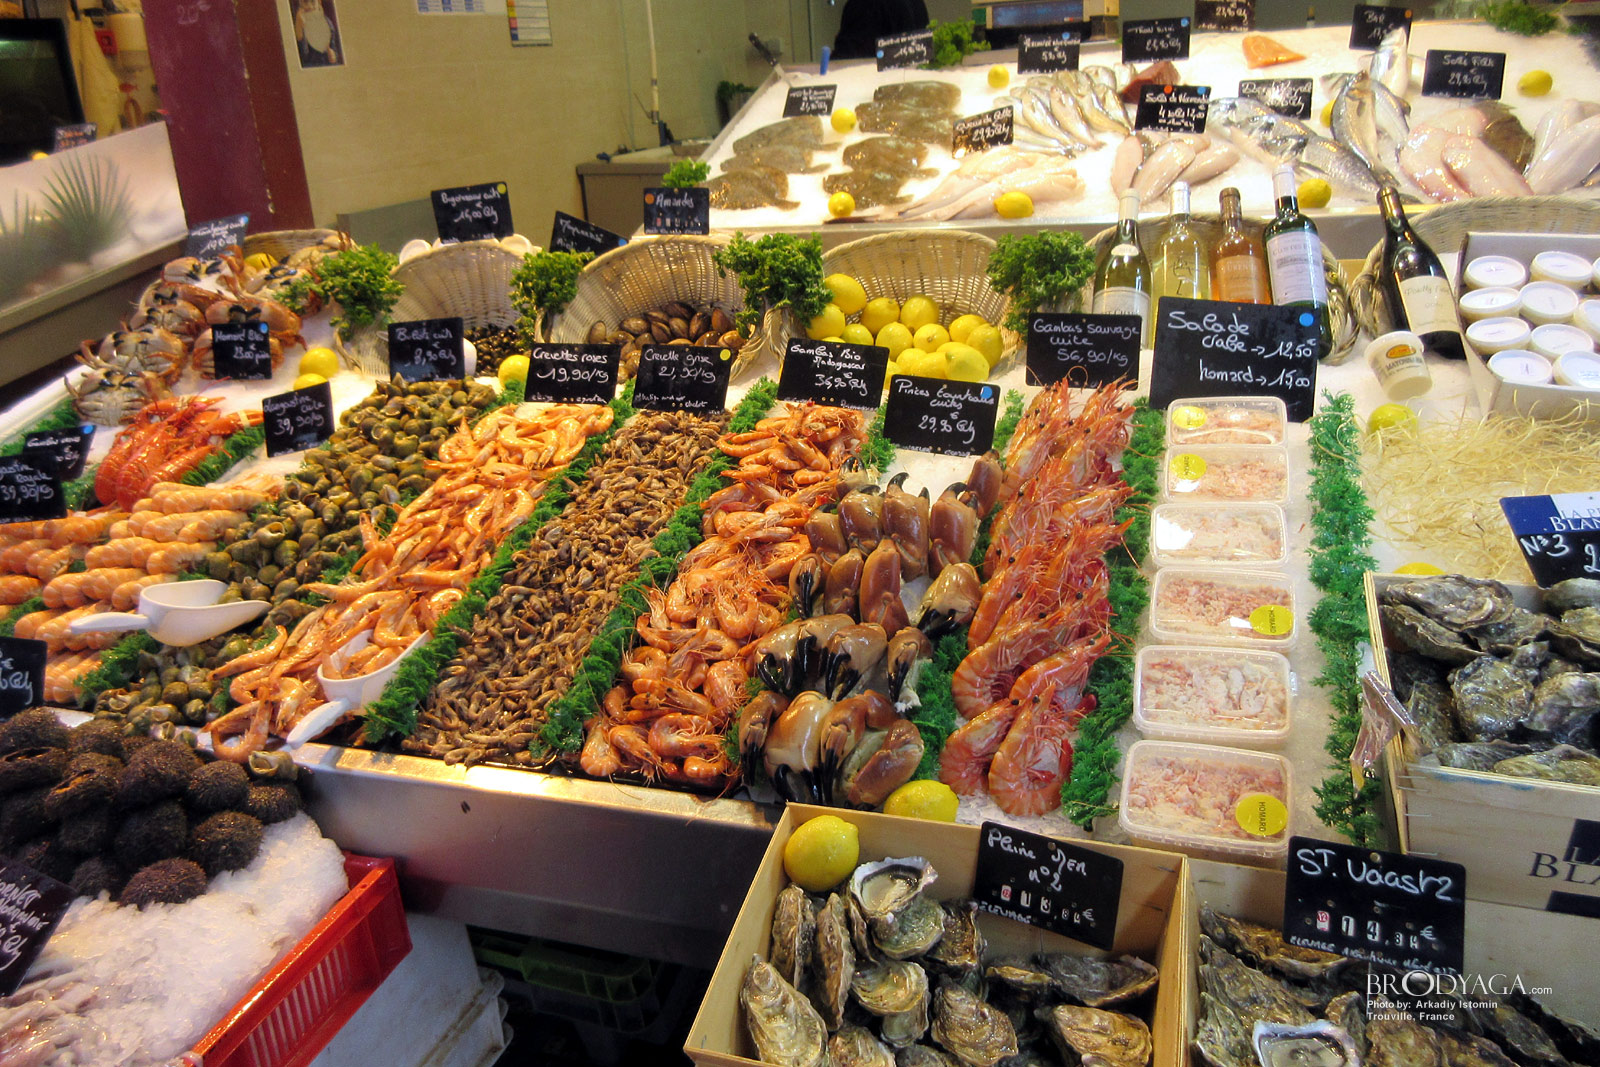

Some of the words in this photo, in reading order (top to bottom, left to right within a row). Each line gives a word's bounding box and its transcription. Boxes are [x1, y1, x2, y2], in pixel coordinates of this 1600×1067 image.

[1033, 318, 1082, 333] Gambas
[1168, 311, 1249, 335] Salade
[533, 347, 578, 362] Crevettes
[644, 348, 680, 361] Crevette
[840, 348, 861, 361] Bio
[1258, 801, 1266, 833] HOMARD
